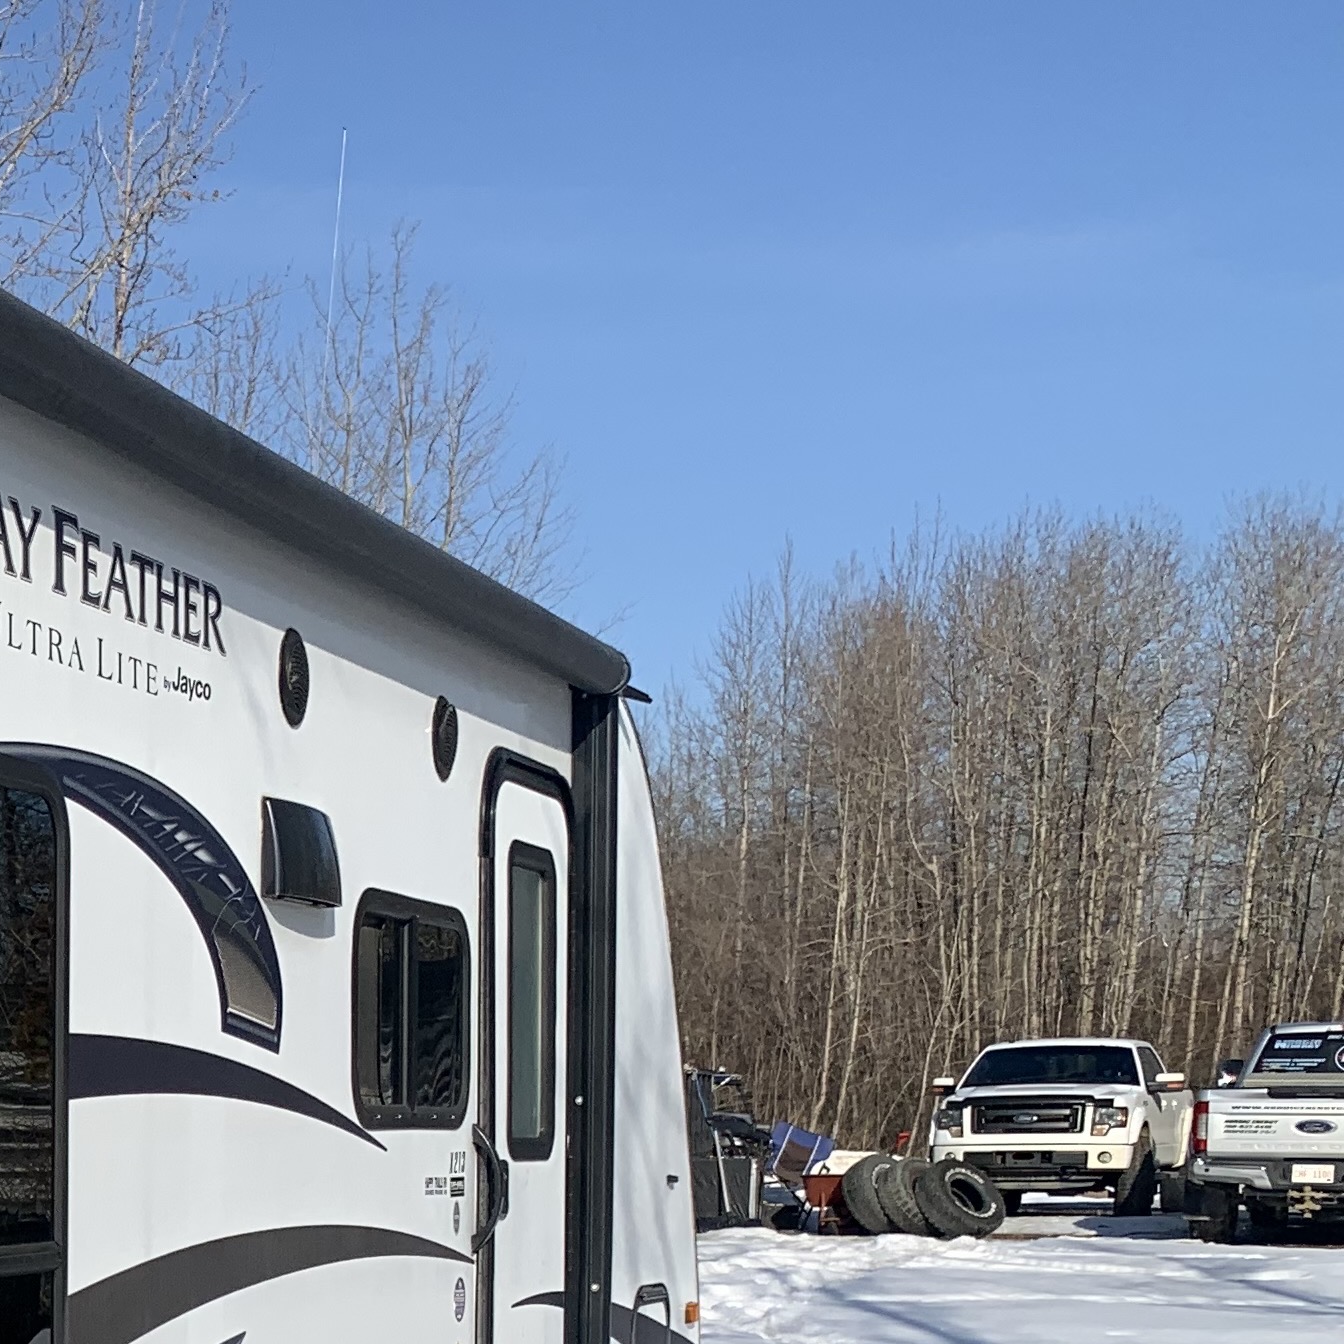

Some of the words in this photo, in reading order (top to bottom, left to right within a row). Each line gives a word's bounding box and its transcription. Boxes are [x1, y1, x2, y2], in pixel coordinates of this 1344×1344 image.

[50, 504, 227, 657] FEATHER
[96, 637, 159, 697] LITE
[172, 666, 212, 702] Jayco
